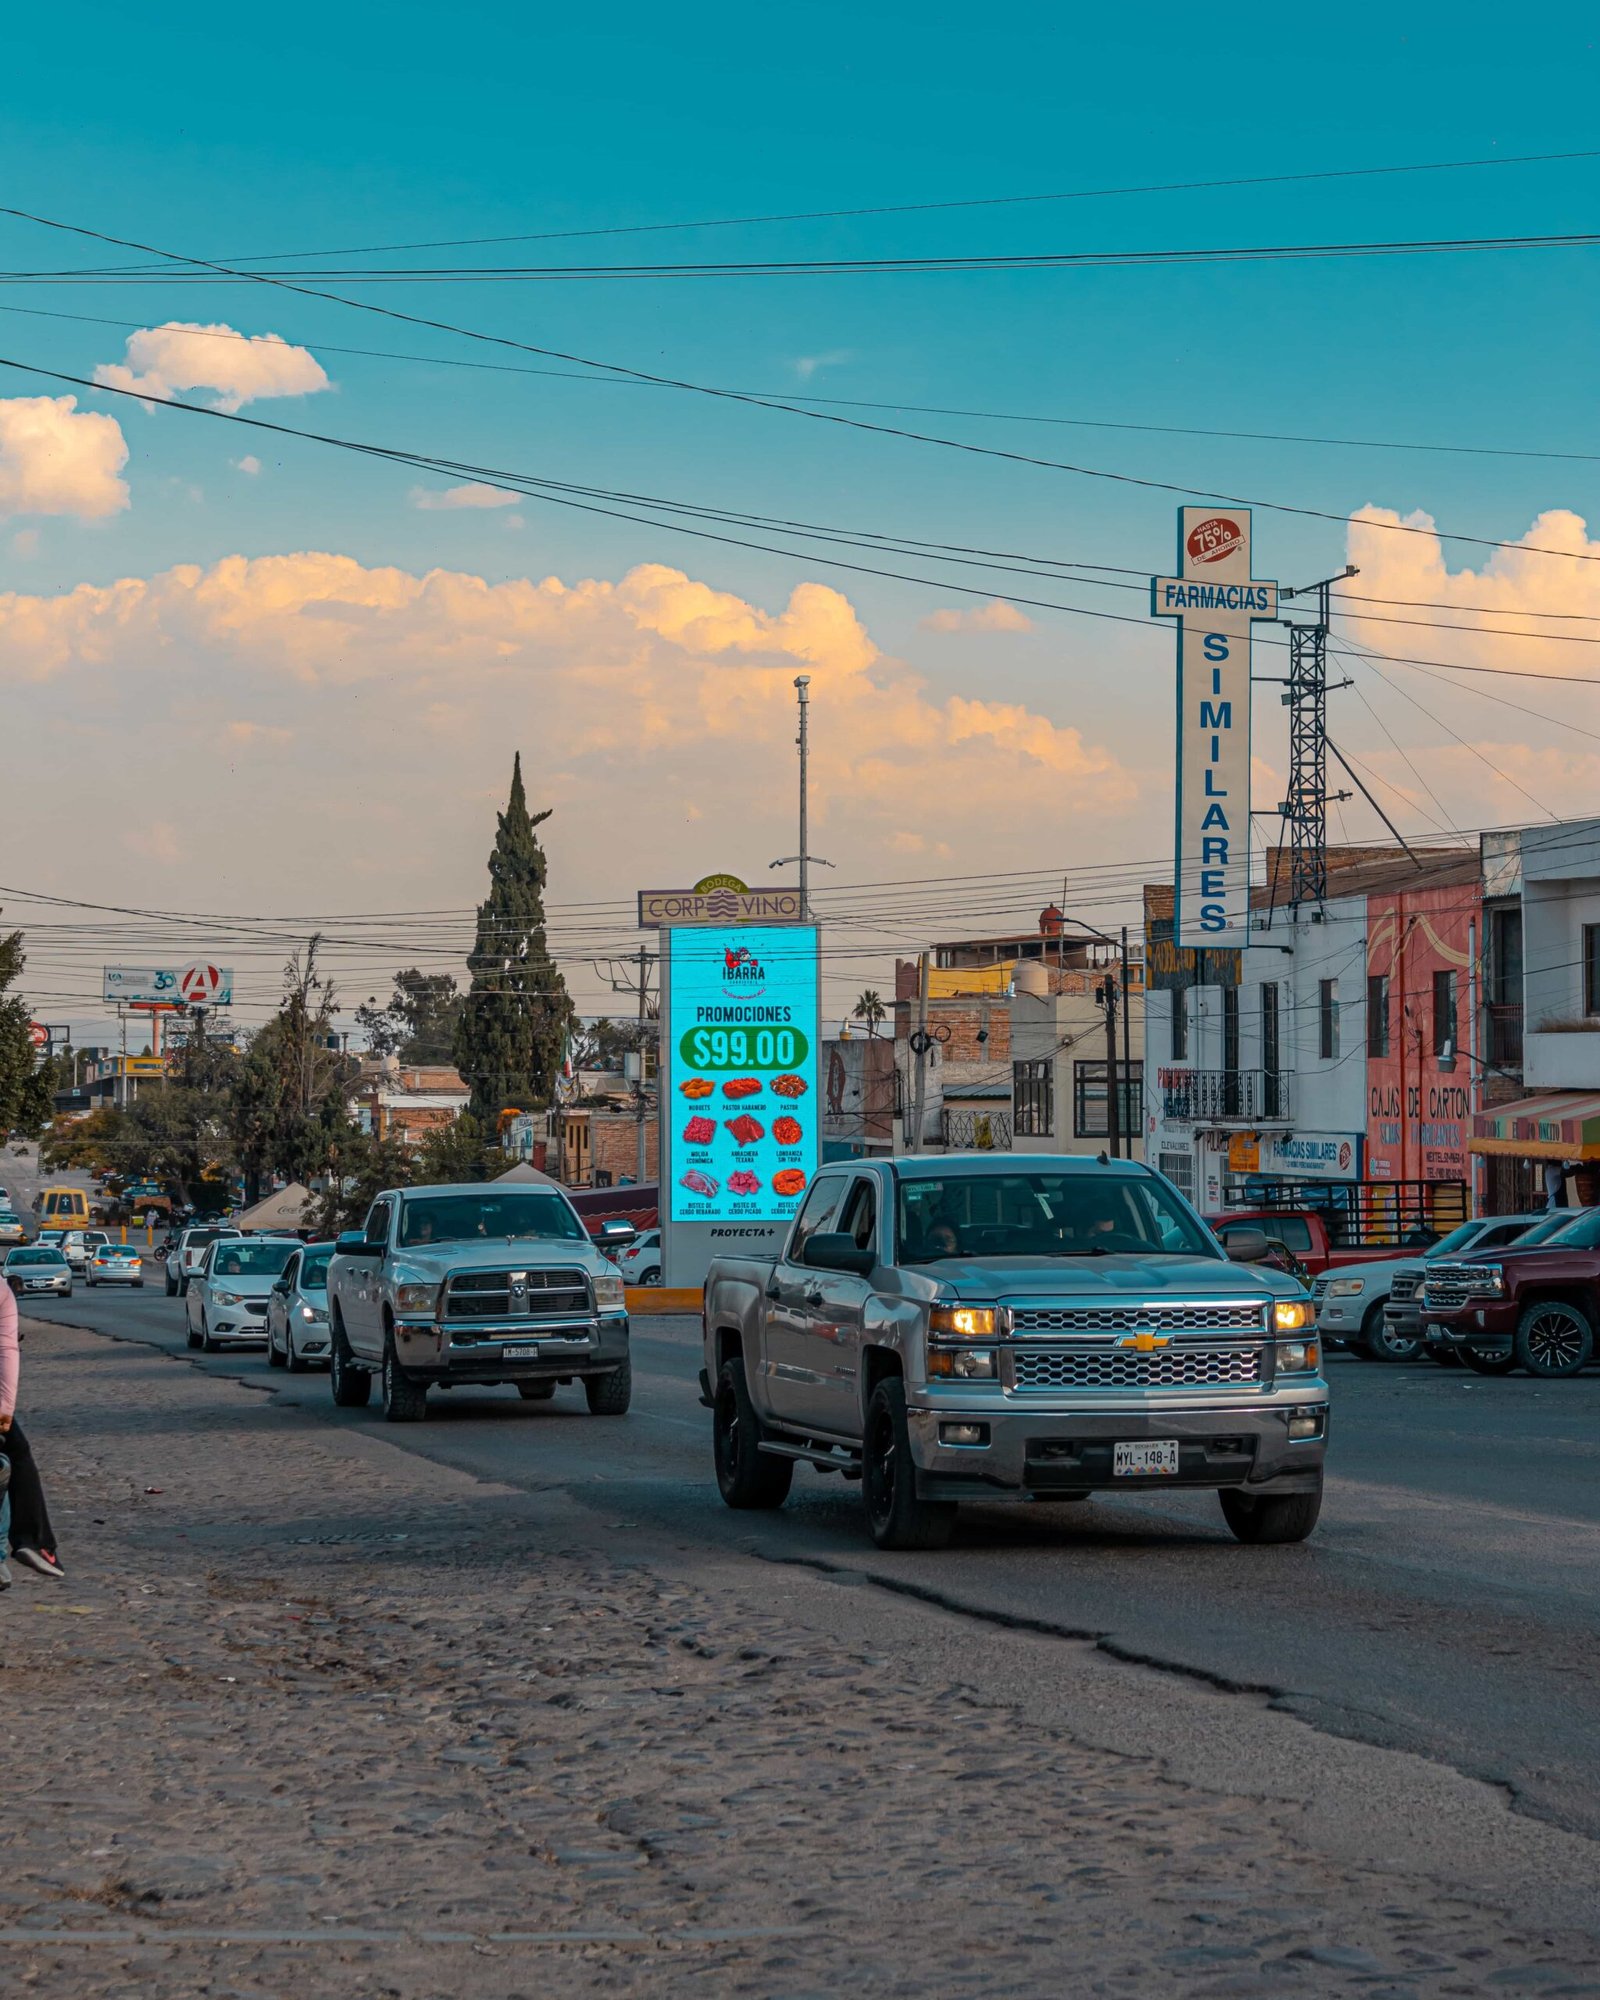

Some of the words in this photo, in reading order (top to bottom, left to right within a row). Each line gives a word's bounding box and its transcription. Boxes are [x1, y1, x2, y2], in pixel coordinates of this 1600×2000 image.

[1197, 520, 1218, 533] HASTA
[1193, 524, 1232, 552] 75%
[1211, 539, 1240, 556] AHORRO
[1165, 585, 1268, 610] FARMACIAS
[1200, 634, 1232, 932] SIMILARES
[700, 877, 742, 893] BODEGA
[722, 967, 766, 980] IBARRA
[697, 1006, 791, 1022] PROMOCIONES
[694, 1030, 794, 1067] $99.00
[1371, 1087, 1400, 1118] CAJAS
[1408, 1087, 1420, 1118] DE
[1429, 1087, 1470, 1119] CARTON
[1116, 1450, 1176, 1466] MYL-148-A
